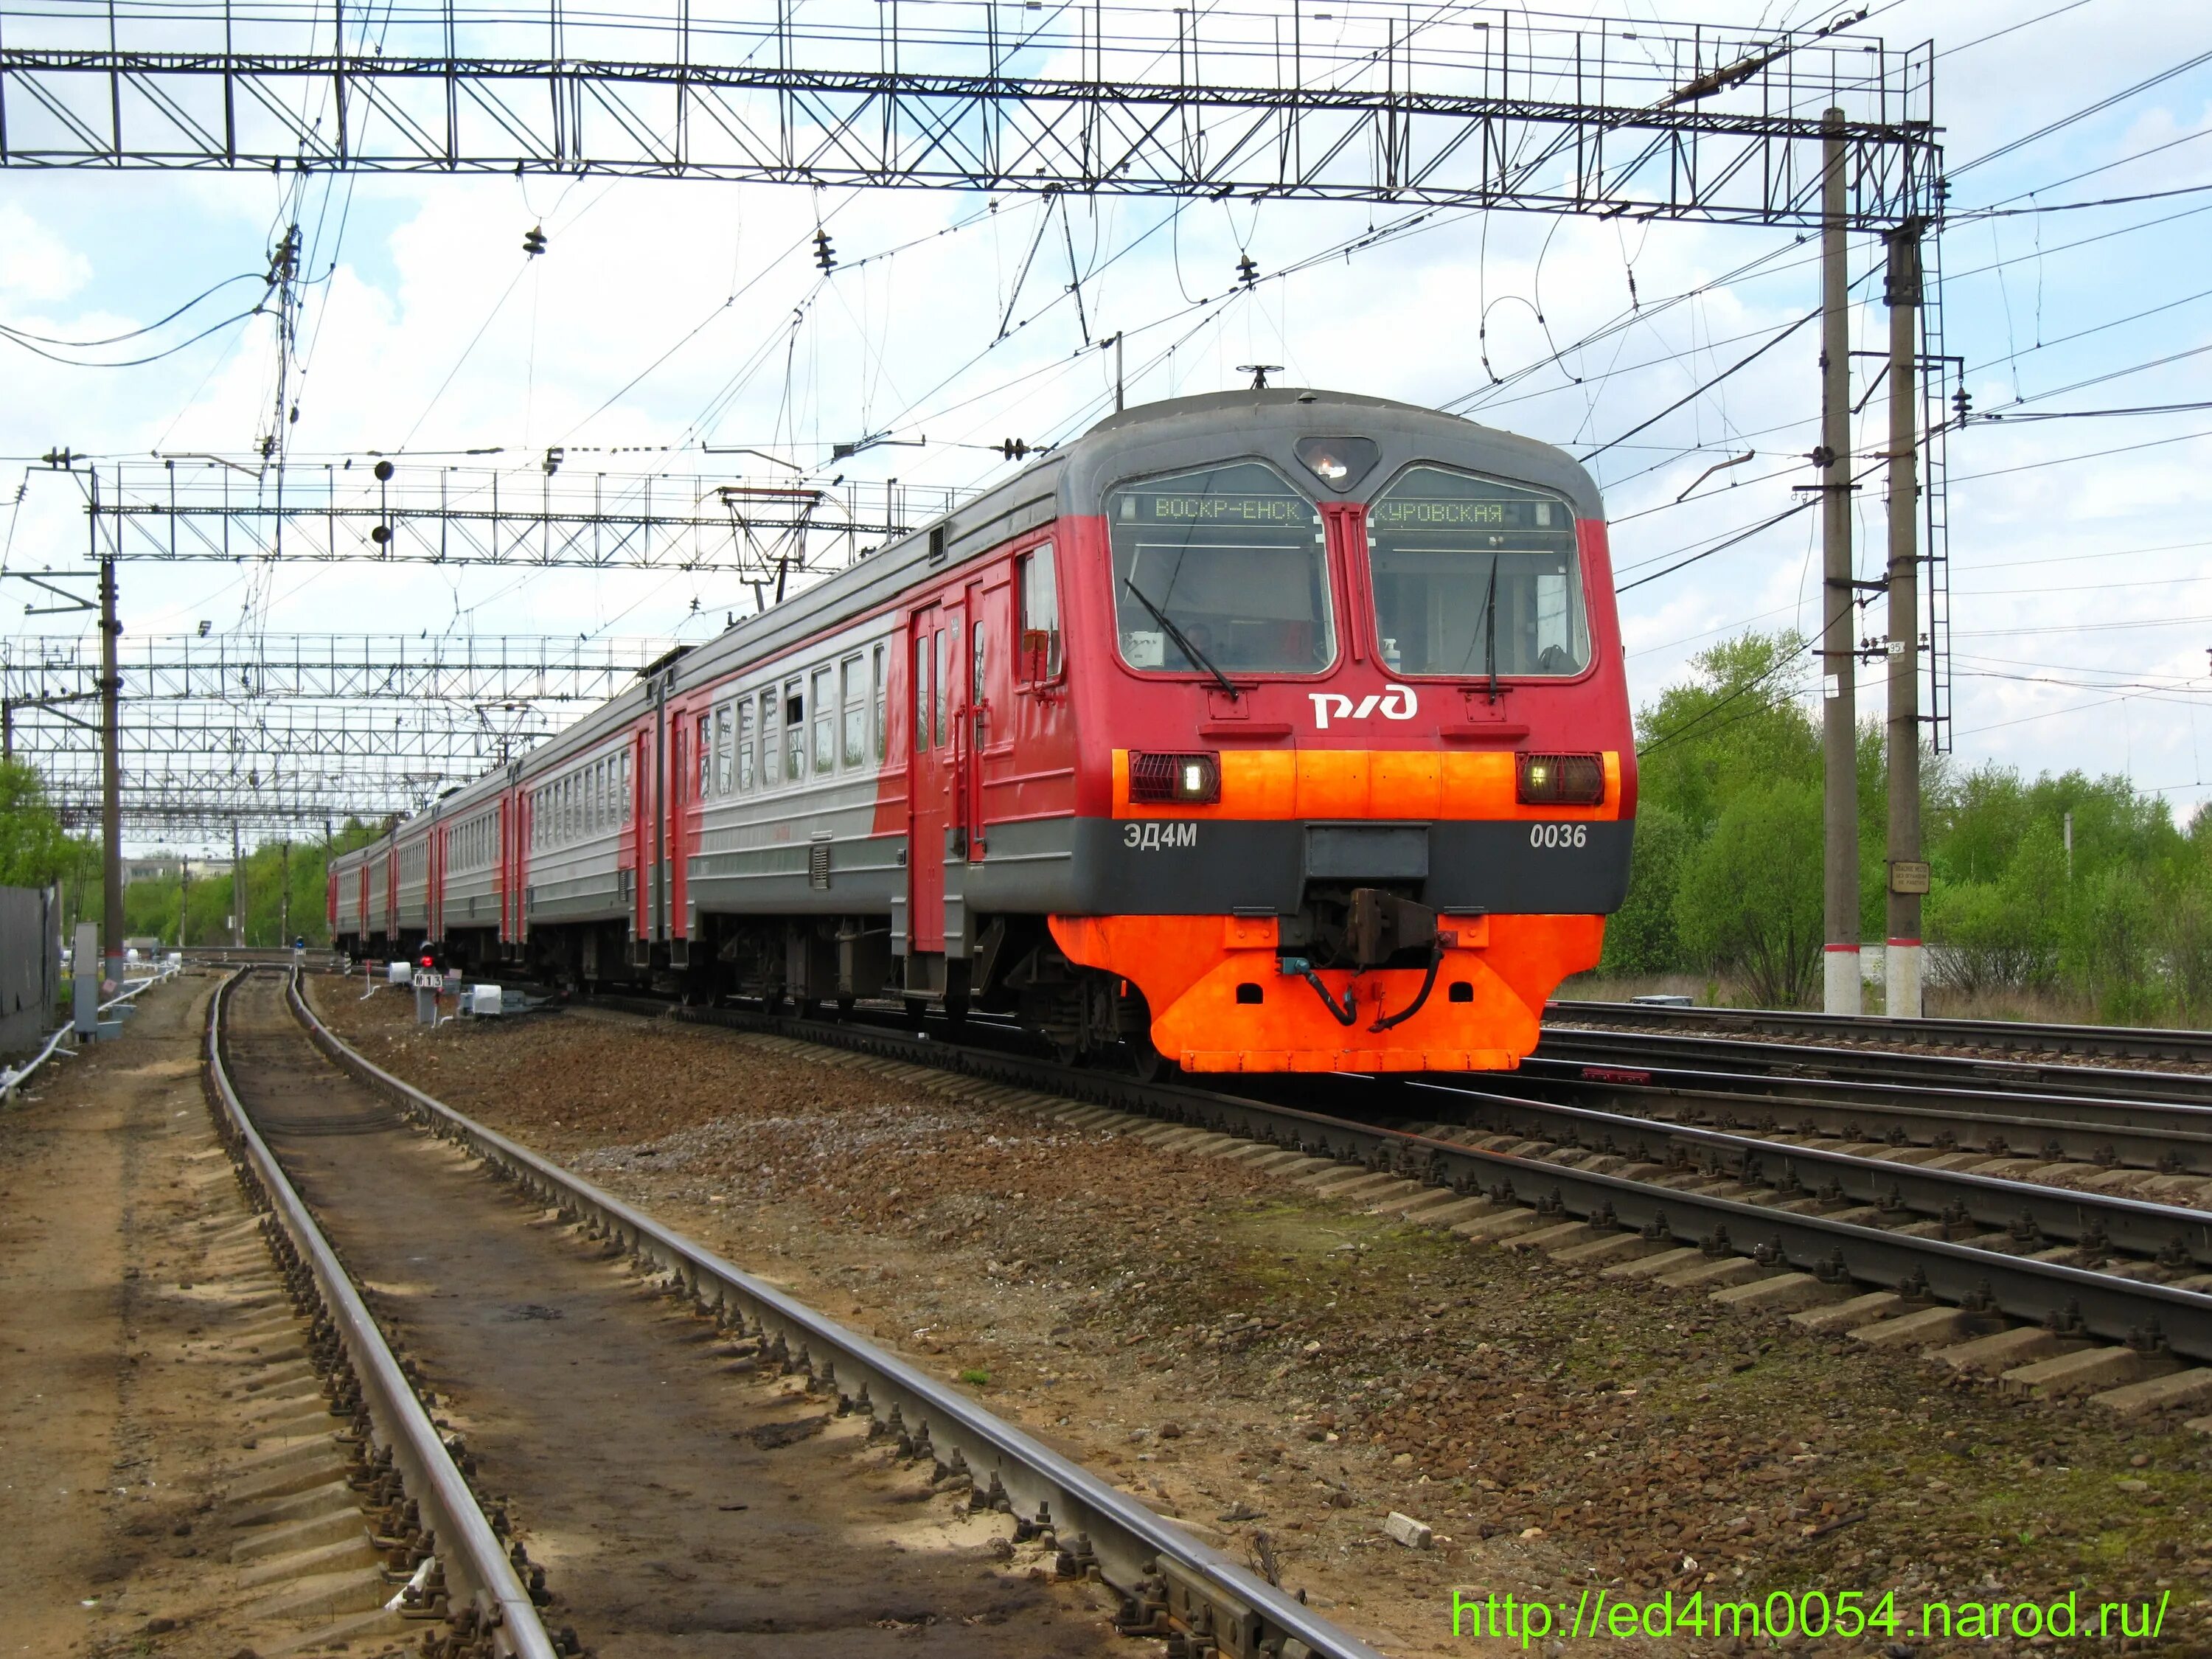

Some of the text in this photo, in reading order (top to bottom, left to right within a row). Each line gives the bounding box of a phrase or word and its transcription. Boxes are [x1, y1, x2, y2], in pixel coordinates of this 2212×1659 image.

[1155, 498, 1300, 520] ВОСКР-ЕНСК
[1374, 503, 1502, 523] КУРОВСКАЯ
[1890, 643, 1901, 653] 95
[1123, 822, 1197, 852] ЭД4М
[1530, 824, 1587, 848] 0036
